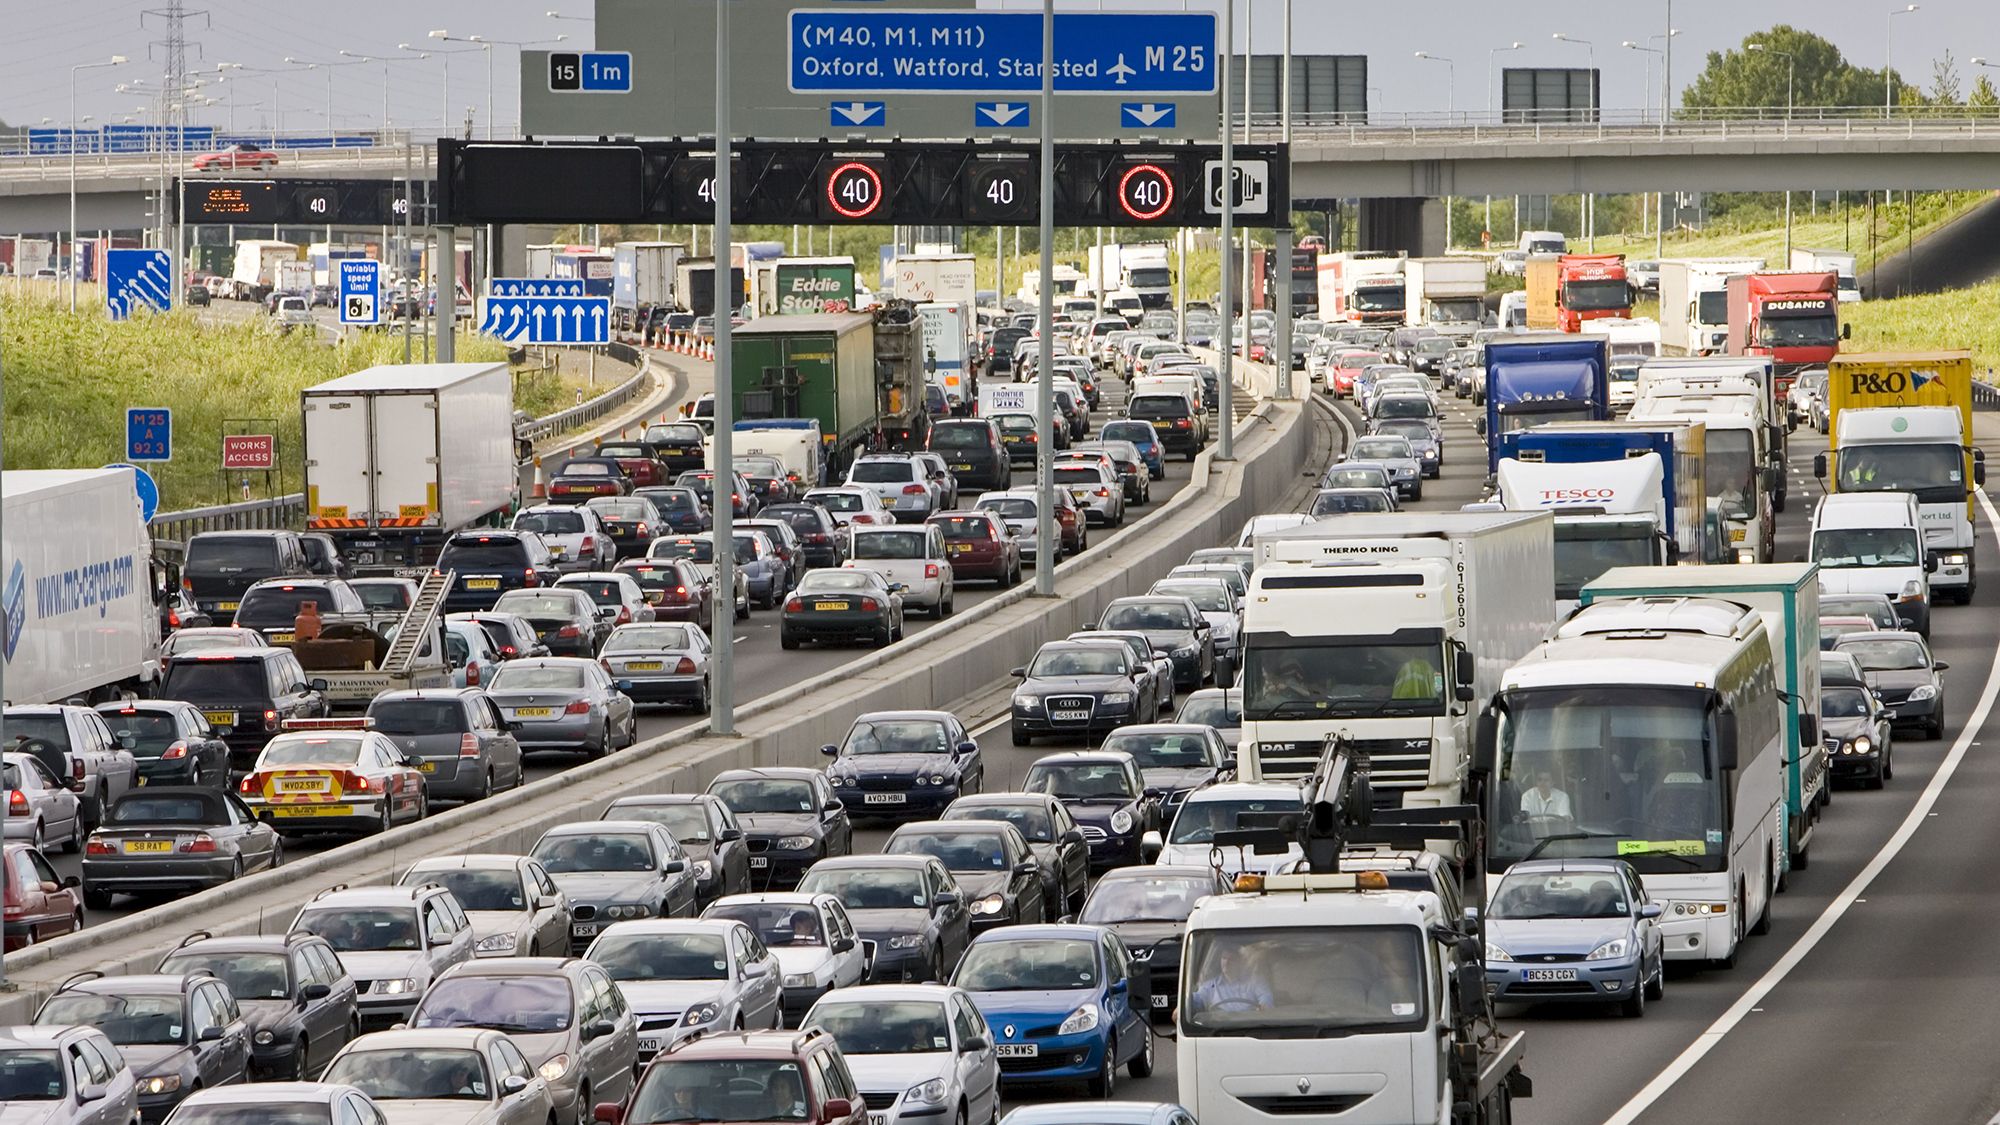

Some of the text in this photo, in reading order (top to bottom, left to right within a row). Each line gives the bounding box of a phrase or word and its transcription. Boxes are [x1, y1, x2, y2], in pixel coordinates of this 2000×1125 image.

[555, 65, 575, 81] 15
[590, 62, 622, 81] 1m
[802, 57, 885, 79] Oxford,
[893, 57, 990, 79] Watford,
[842, 178, 870, 203] 40
[986, 178, 1014, 205] 40
[1134, 180, 1161, 206] 40
[310, 197, 326, 213] 40
[343, 264, 376, 273] Variable
[347, 274, 372, 284] speed
[350, 283, 369, 291] limit
[791, 278, 841, 293] Eddie
[1850, 371, 1907, 395] P&O
[145, 428, 154, 439] A
[230, 441, 267, 450] WORKS
[228, 453, 268, 462] ACCESS
[1539, 488, 1615, 499] TESCO
[36, 555, 134, 619] www.mc-cargo.com
[1260, 743, 1296, 752] DAF
[1404, 740, 1430, 748] XF
[148, 842, 163, 850] RAT
[576, 926, 594, 935] FSK
[1529, 970, 1575, 980] BC53 CGX
[1013, 1045, 1034, 1055] WWS
